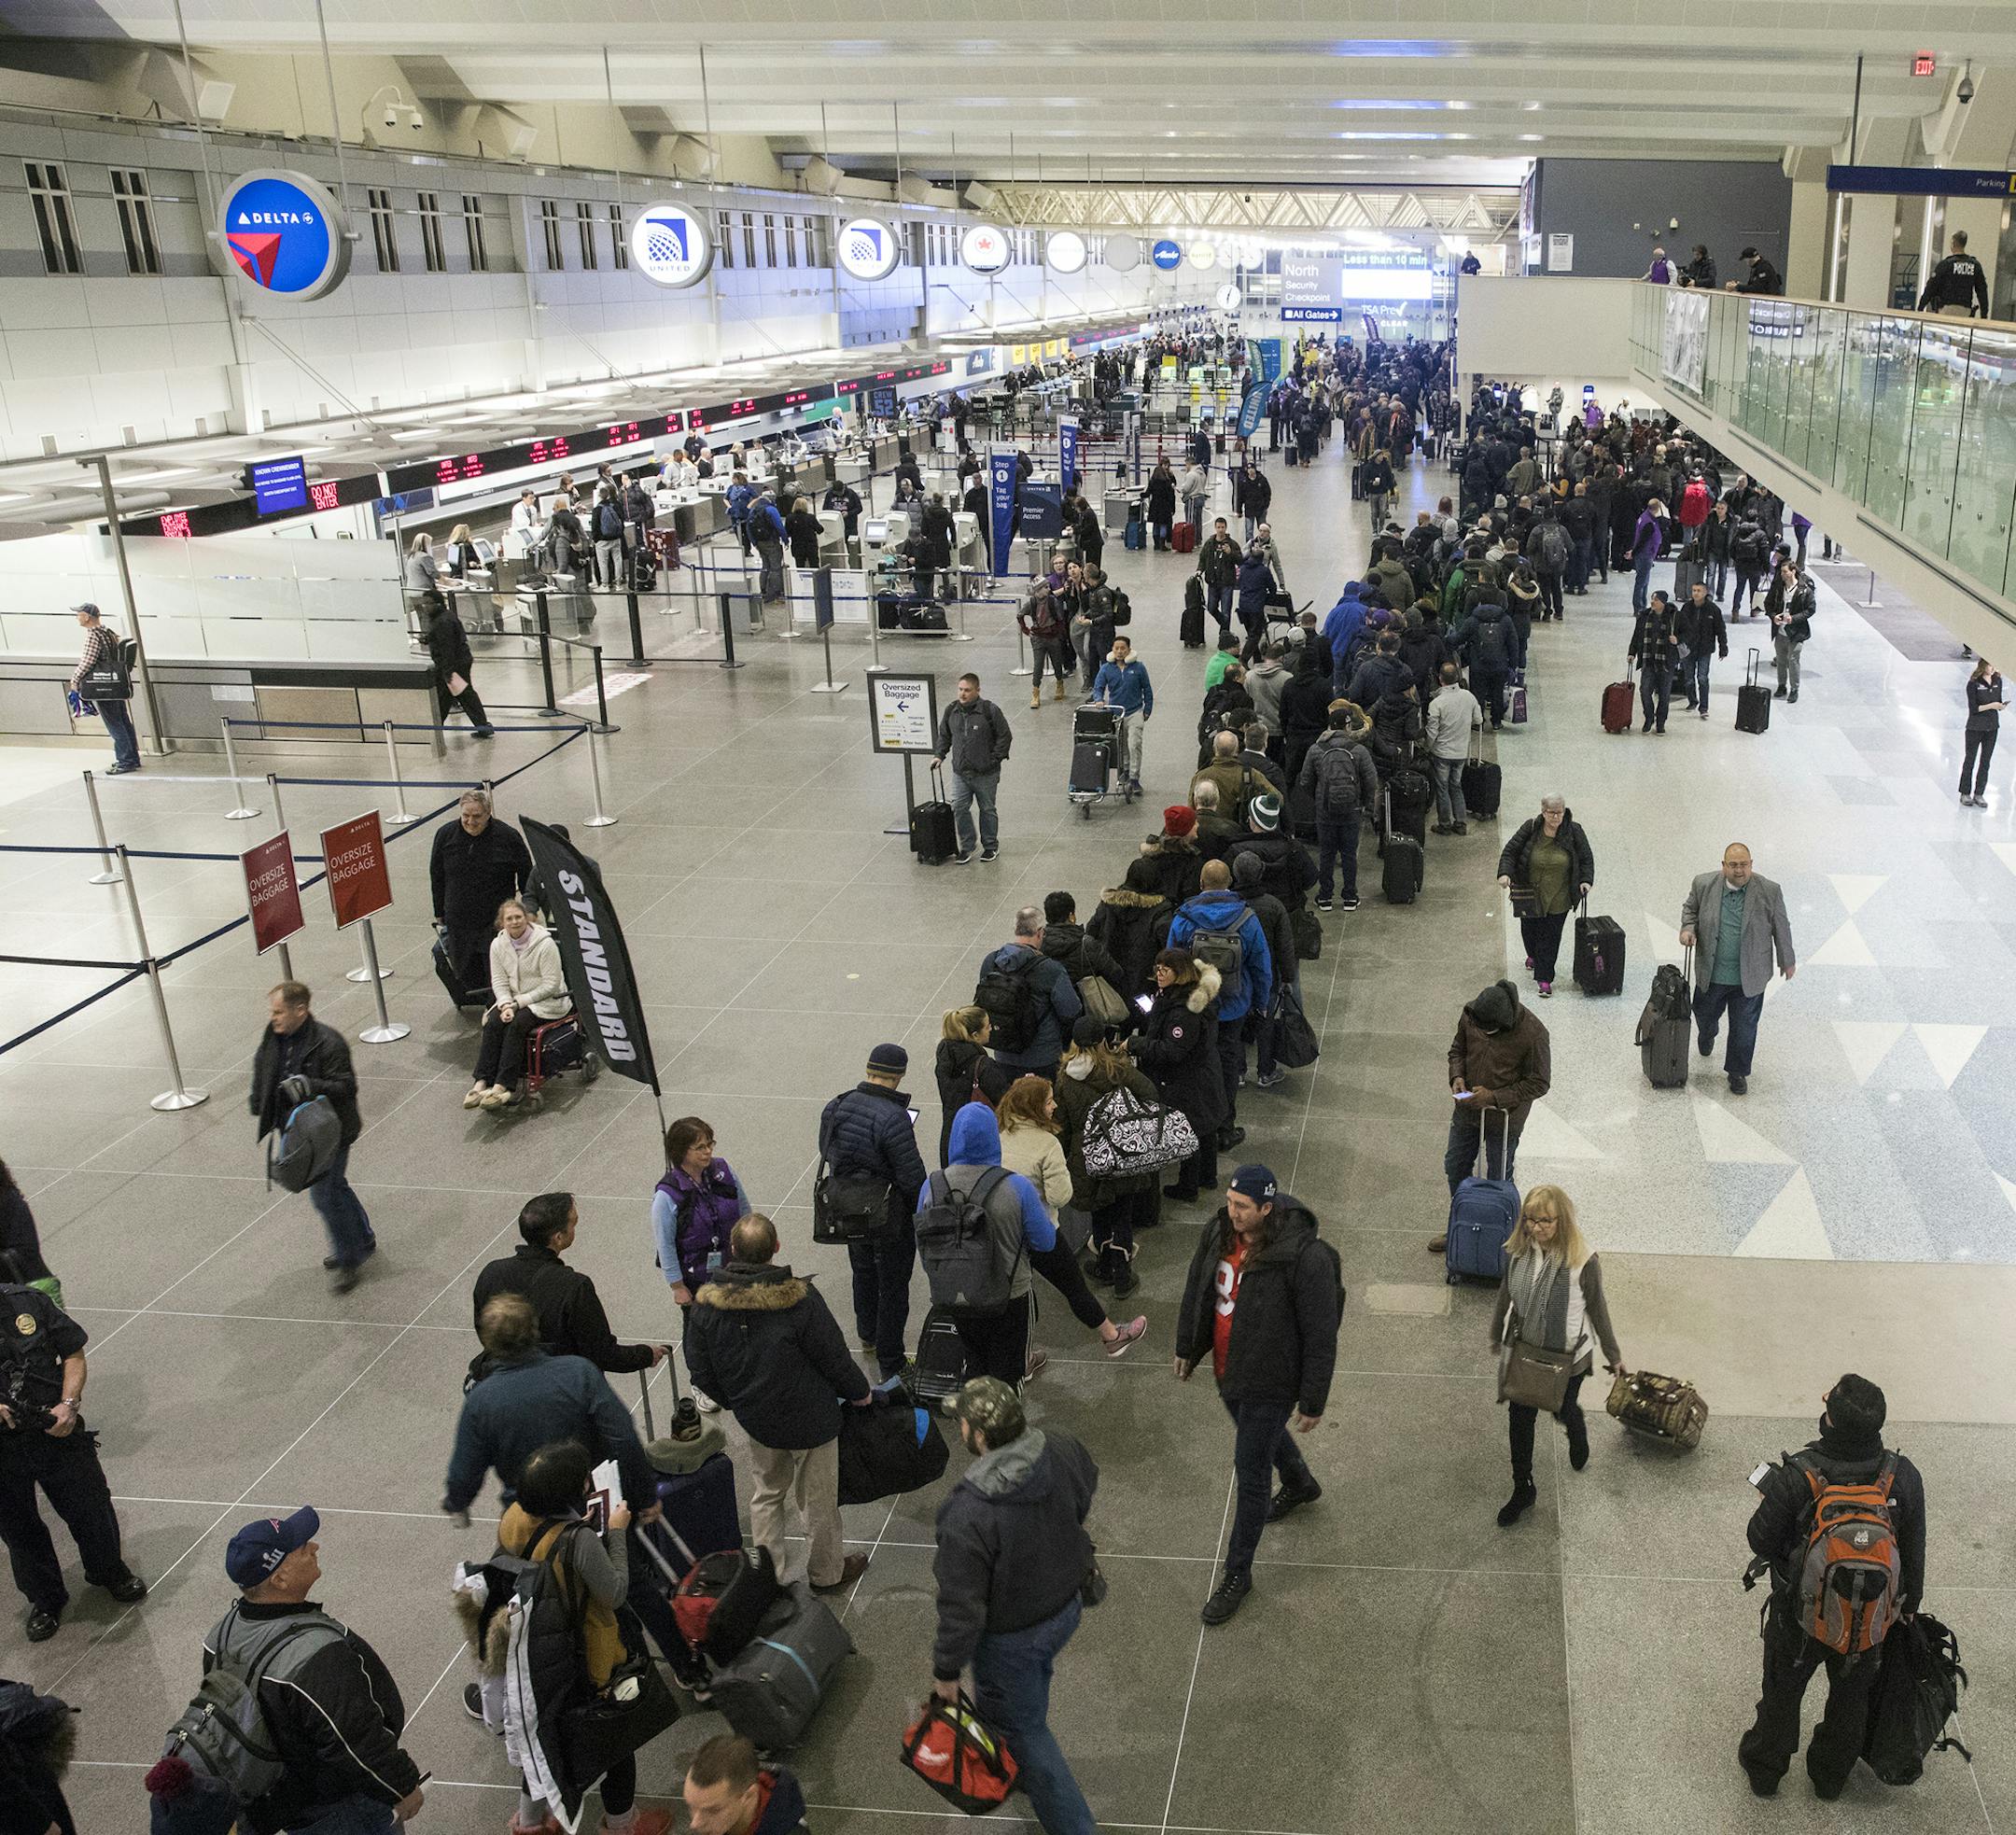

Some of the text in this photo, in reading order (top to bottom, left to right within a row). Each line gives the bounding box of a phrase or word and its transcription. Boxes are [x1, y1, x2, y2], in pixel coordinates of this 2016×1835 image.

[1916, 61, 1932, 75] EXIT
[1976, 178, 2006, 189] Parking
[252, 212, 300, 224] DELTA
[1343, 254, 1427, 265] Less than 10 min
[1285, 264, 1319, 276] North
[1953, 262, 1975, 275] POLICE
[1285, 280, 1318, 291] Security
[1285, 293, 1330, 302] Checkpoint
[1294, 310, 1330, 319] All Gates
[1362, 305, 1379, 315] TSA
[873, 390, 893, 399] CREW
[873, 399, 893, 416] 52
[311, 486, 322, 499] DO
[322, 483, 337, 497] NOT
[315, 495, 339, 510] ENTER
[885, 691, 919, 699] Baggage
[329, 842, 373, 869] OVERSIZE
[331, 856, 376, 883] BAGGAGE
[249, 863, 287, 891] OVERSIZE
[252, 877, 289, 906] BAGGAGE
[558, 869, 637, 1062] STANDARD
